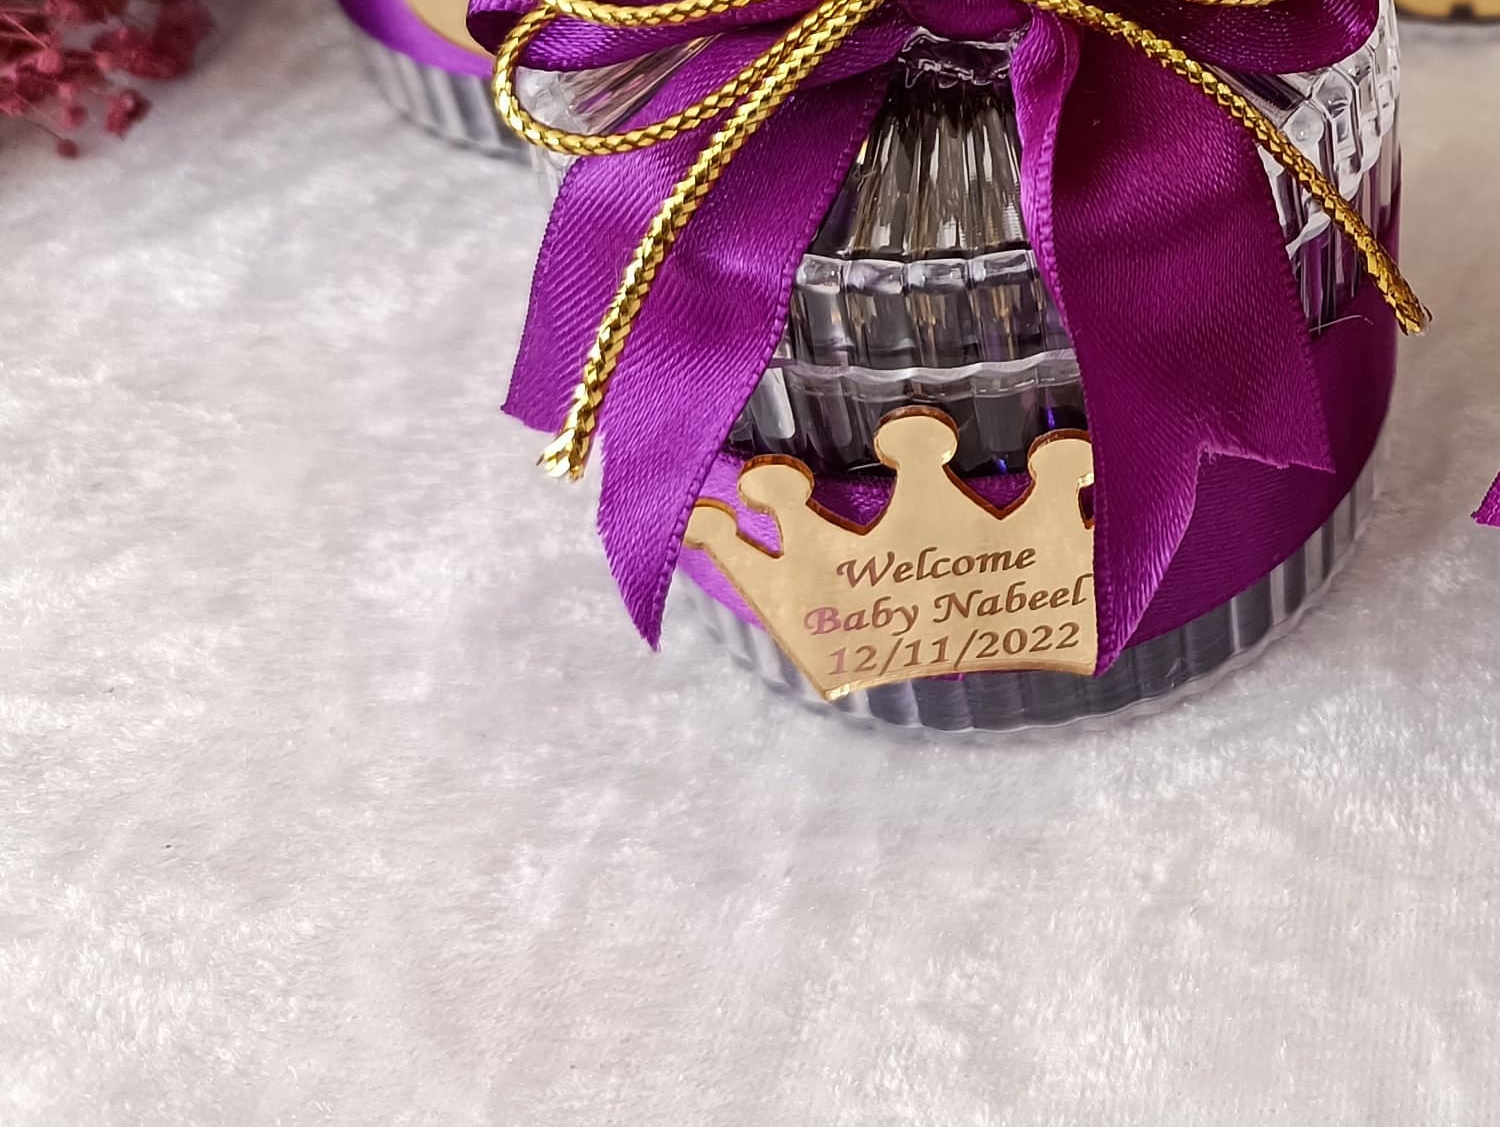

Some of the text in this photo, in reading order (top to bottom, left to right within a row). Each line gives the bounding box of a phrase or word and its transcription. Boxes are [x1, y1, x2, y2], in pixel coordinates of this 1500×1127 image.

[836, 546, 1037, 589] Welcome
[803, 573, 1093, 637] Baby Nabeel
[828, 621, 1081, 677] 12/11/2022
